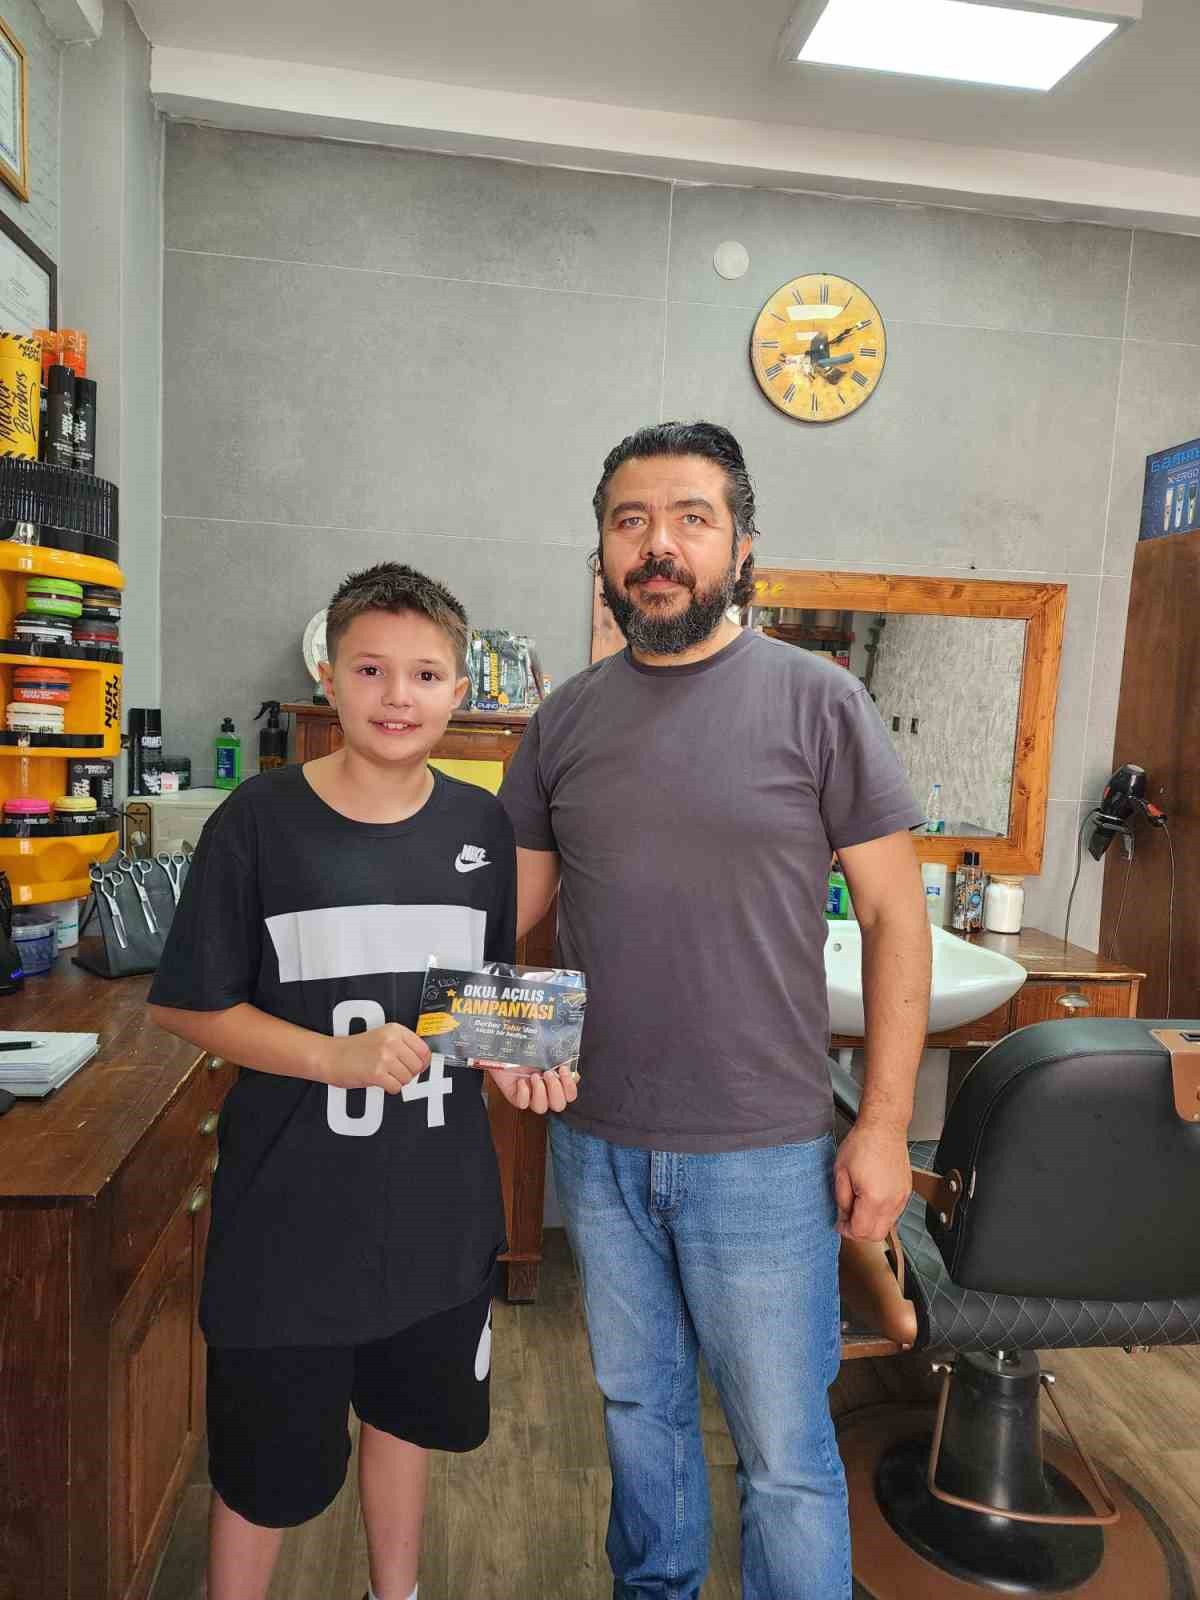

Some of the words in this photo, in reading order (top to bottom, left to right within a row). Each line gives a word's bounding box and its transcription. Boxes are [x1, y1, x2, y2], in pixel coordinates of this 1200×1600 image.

[104, 681, 113, 728] NISH
[461, 844, 486, 862] NIKE
[463, 984, 498, 999] OKUL
[451, 998, 554, 1020] KAMPANYASI
